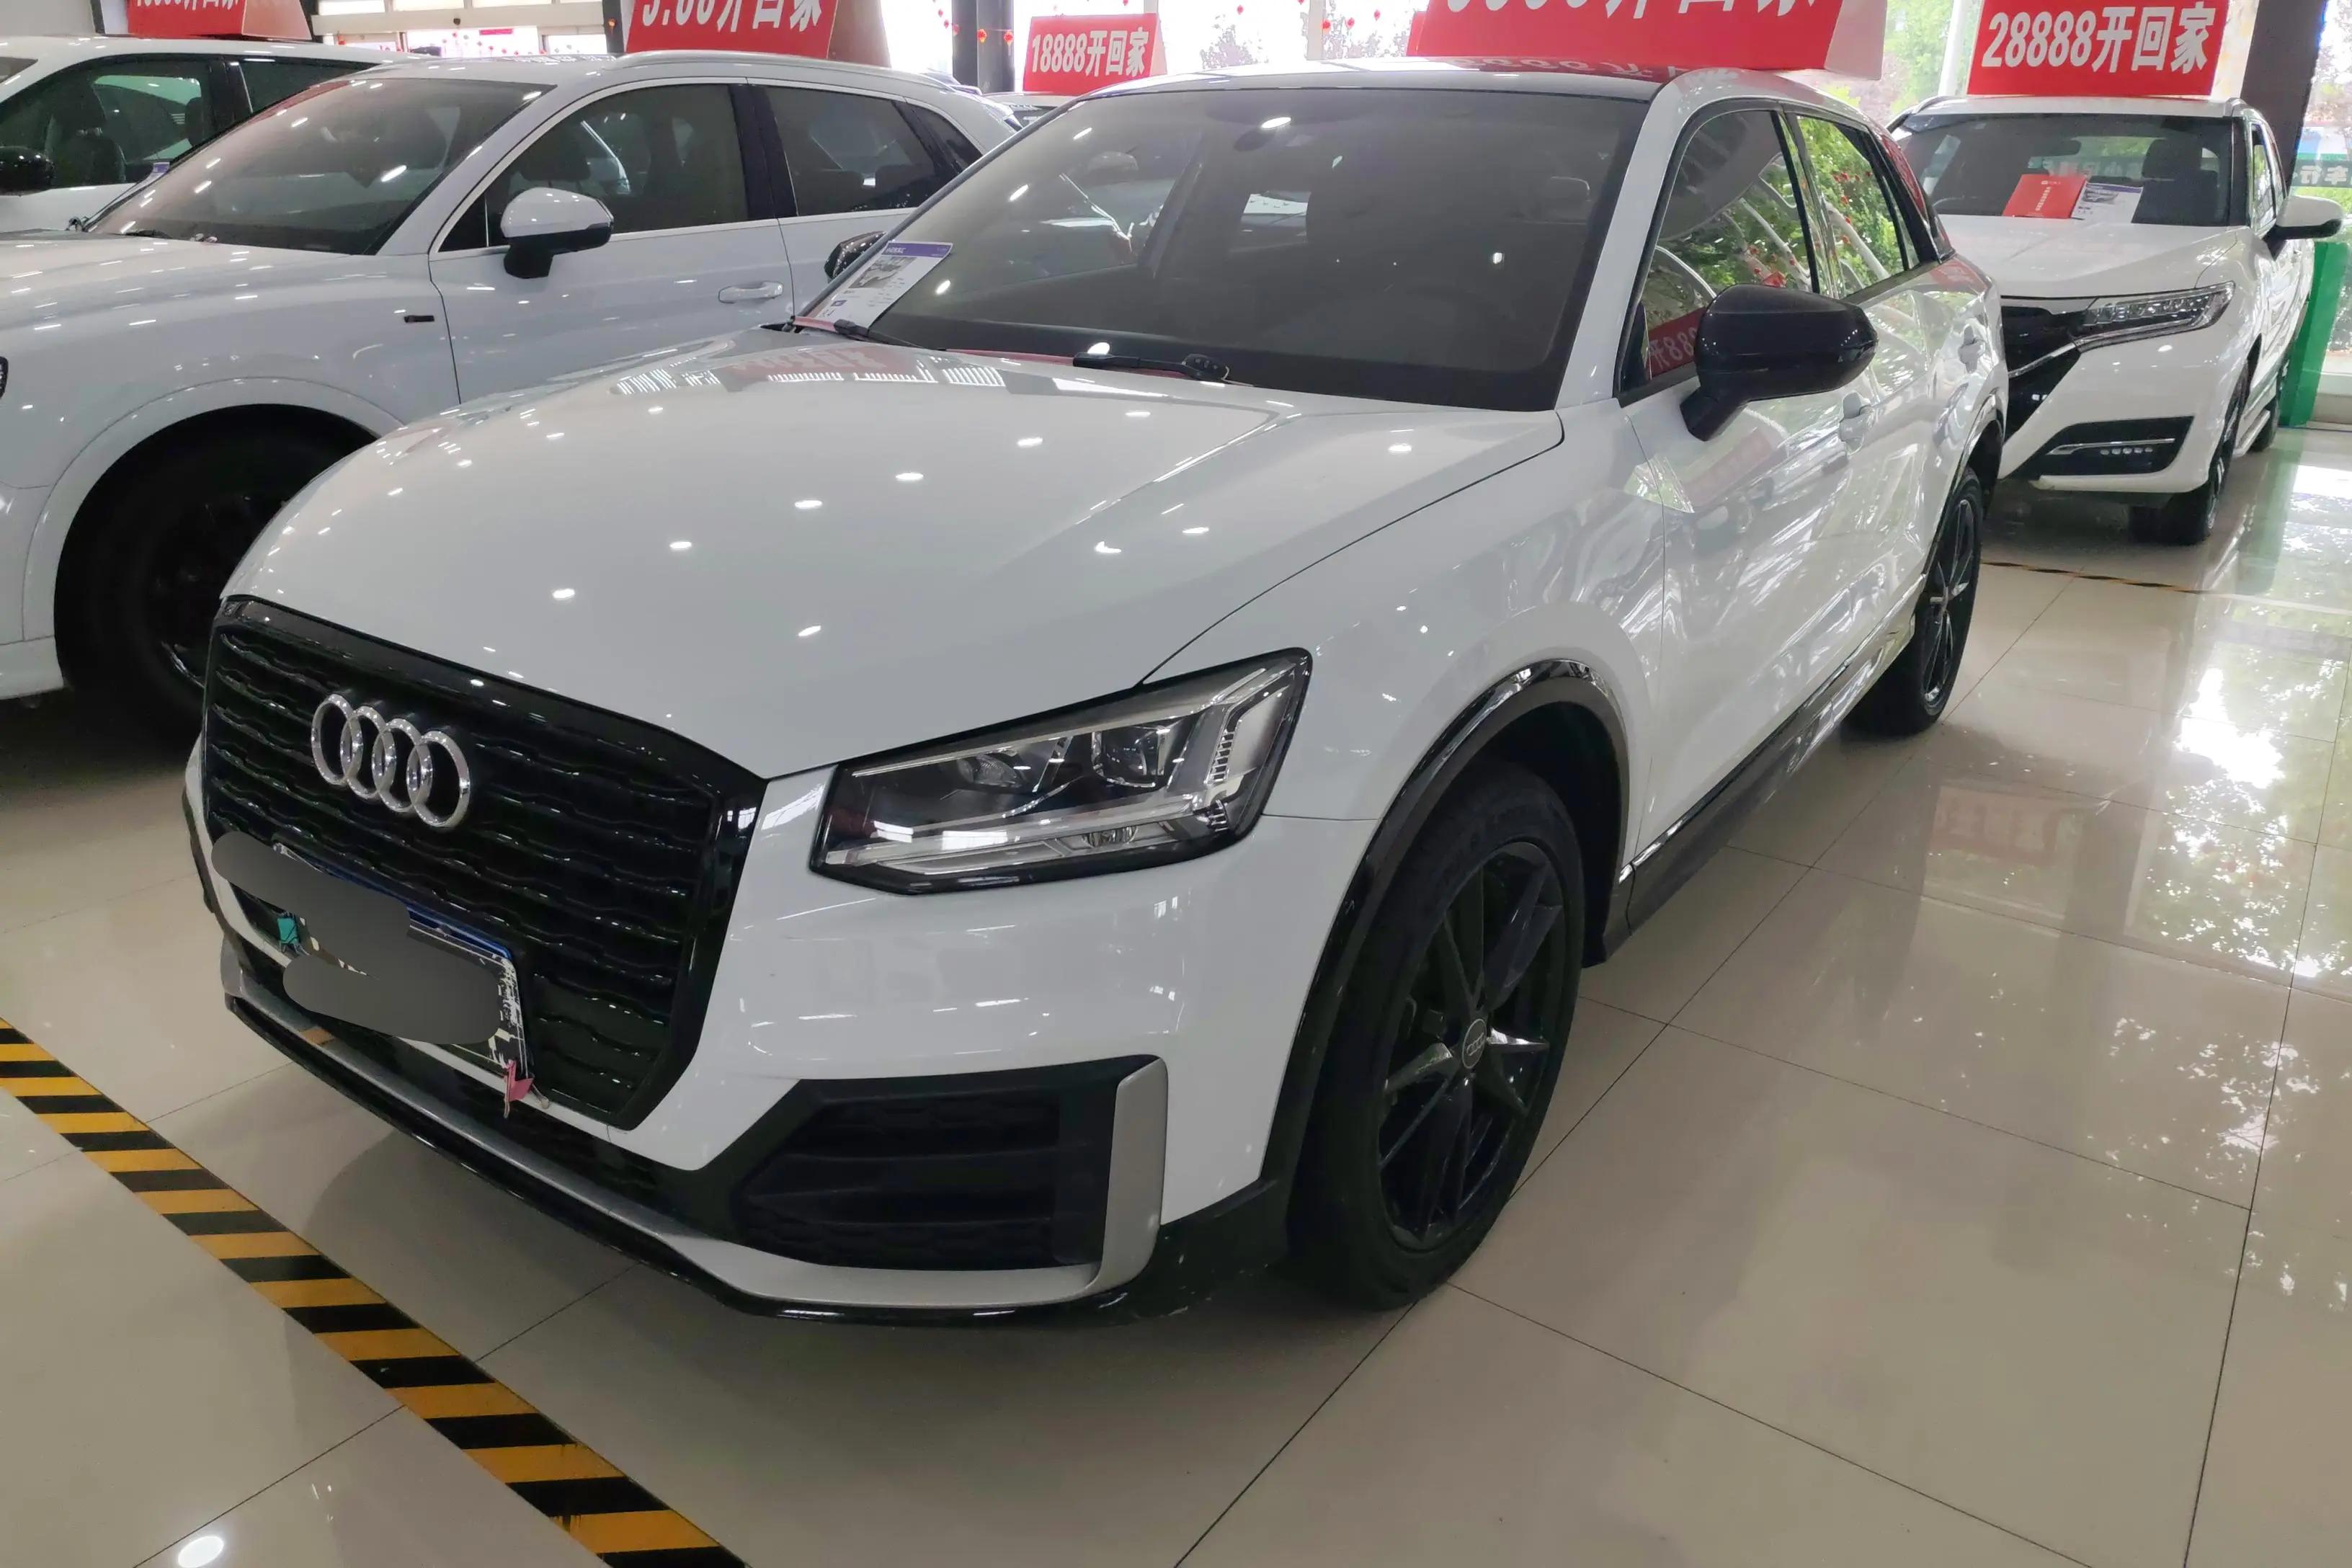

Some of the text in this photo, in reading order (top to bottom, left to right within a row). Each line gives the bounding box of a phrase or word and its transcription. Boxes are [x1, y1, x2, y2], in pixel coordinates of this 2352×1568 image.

[1032, 26, 1149, 77] 18888开回家
[1982, 1, 2217, 74] 28888开回家
